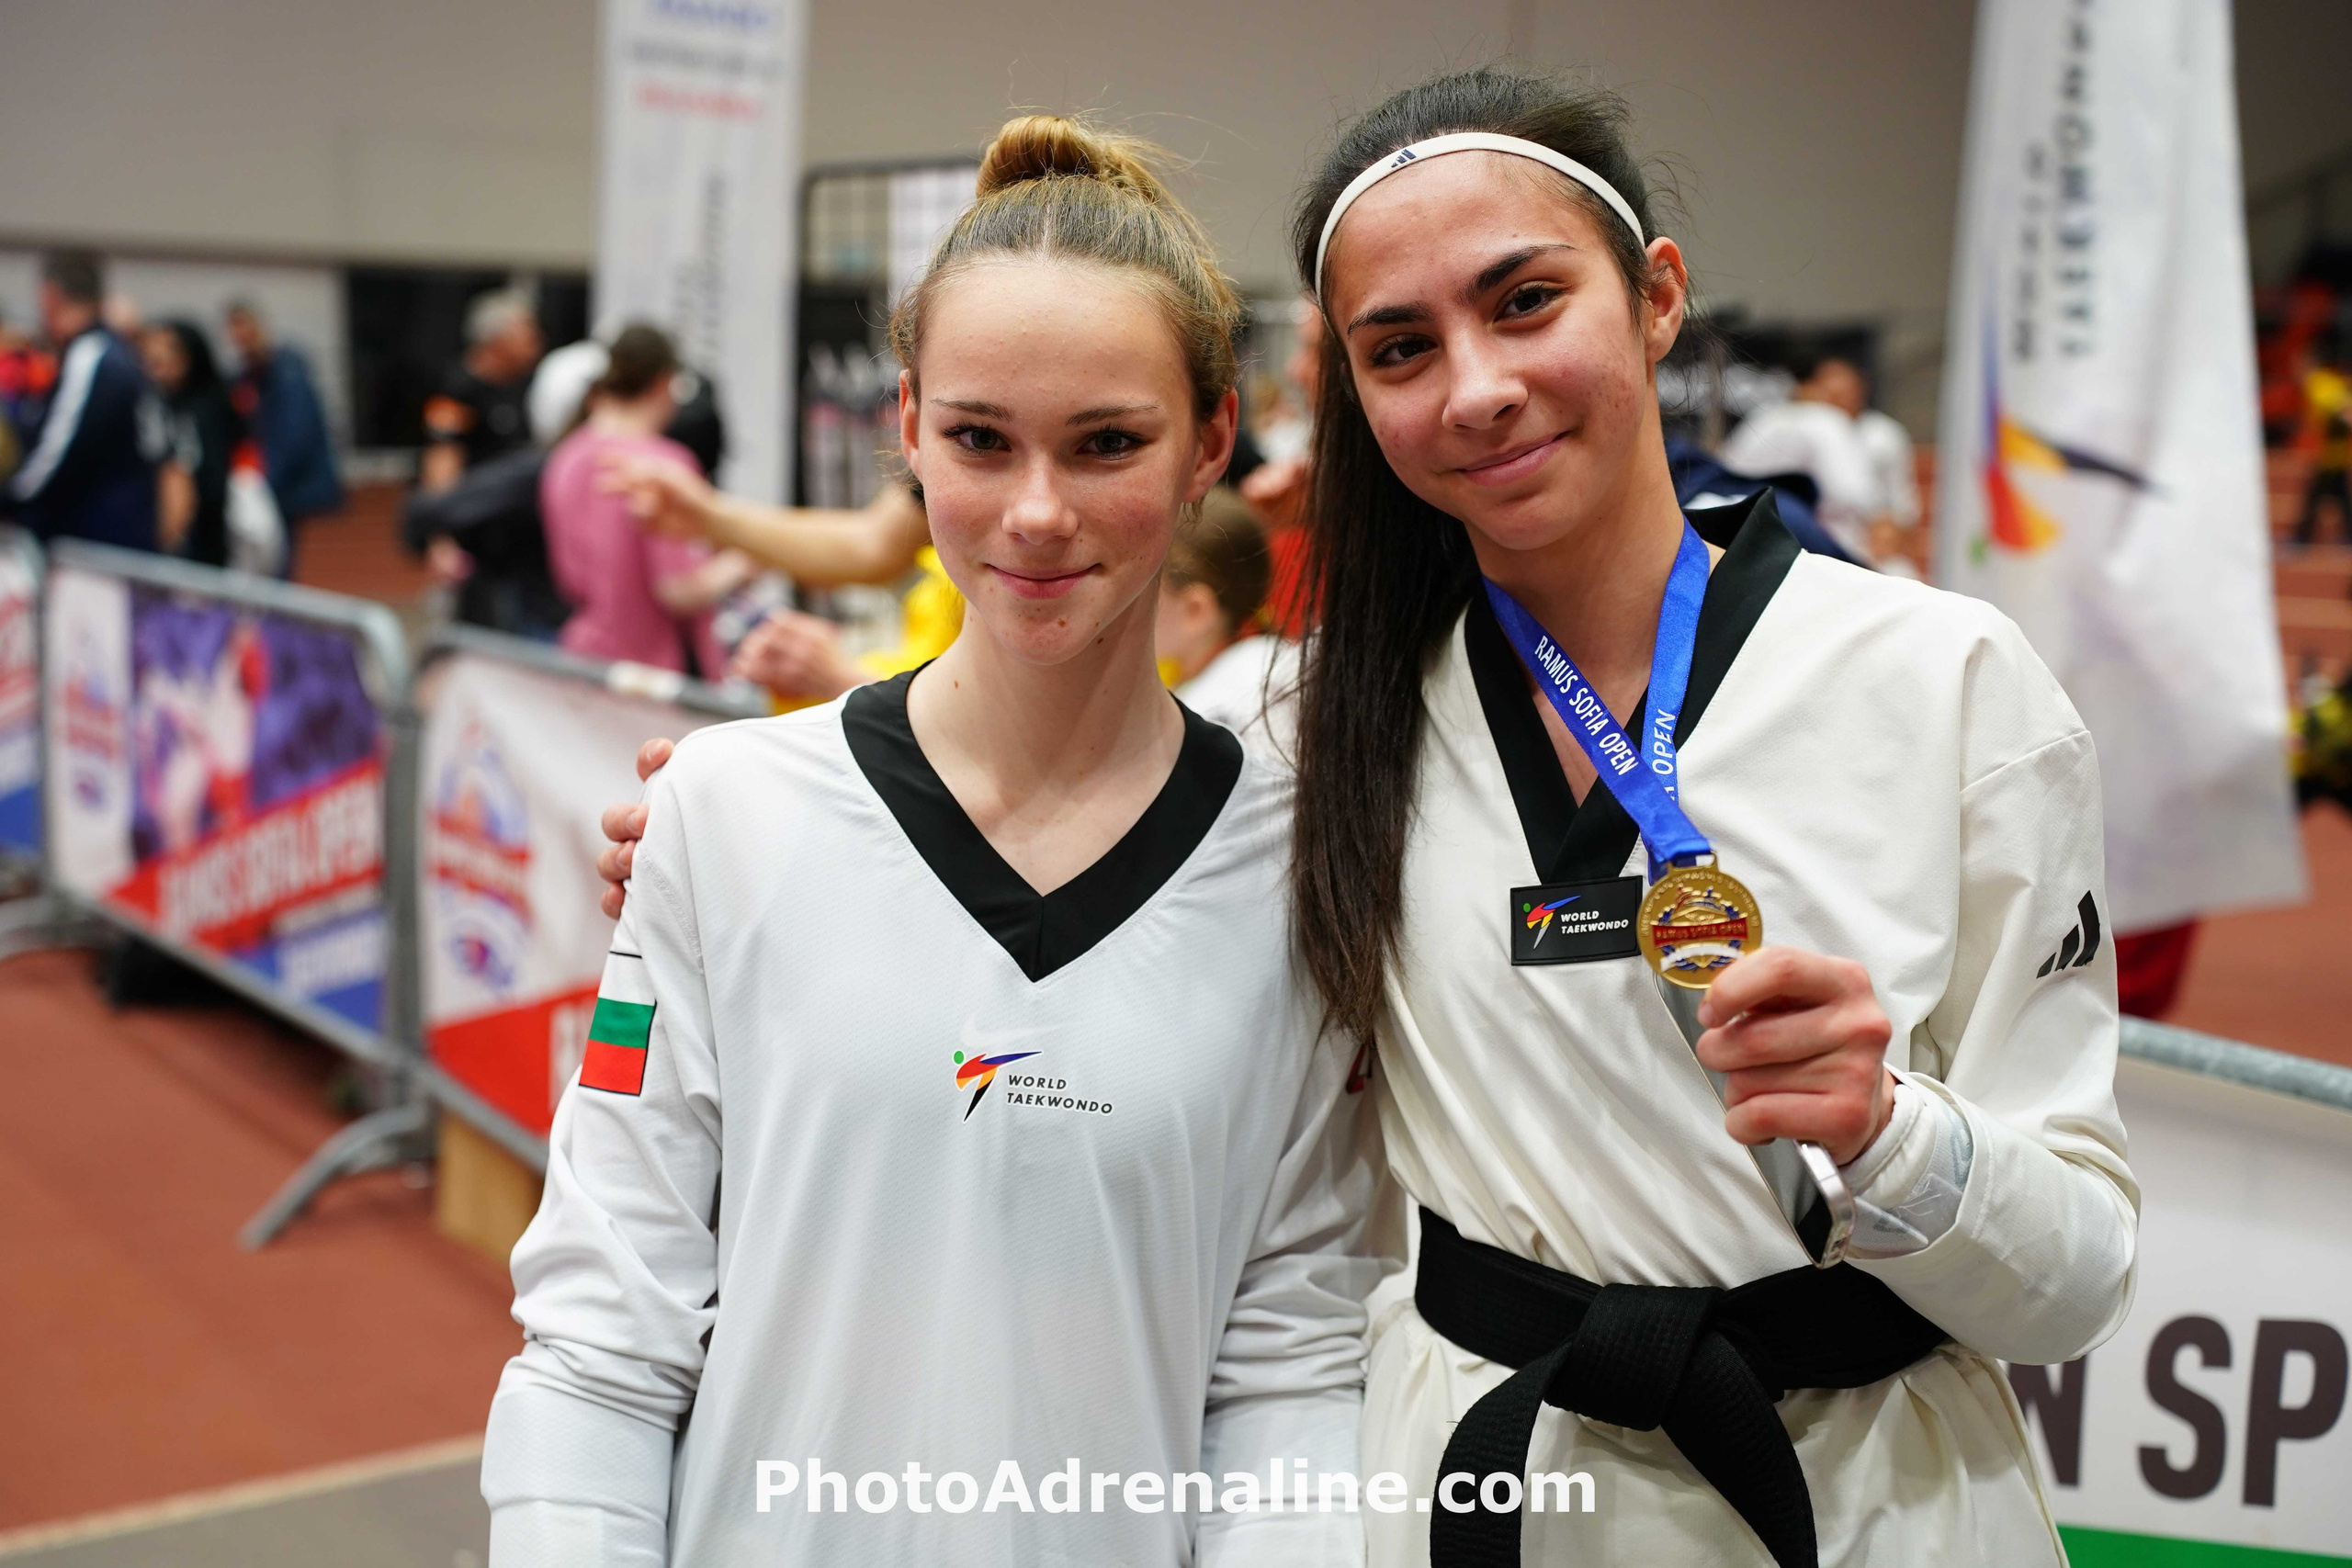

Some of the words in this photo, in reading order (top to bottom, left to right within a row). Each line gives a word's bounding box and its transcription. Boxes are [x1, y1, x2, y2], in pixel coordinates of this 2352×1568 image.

[1534, 635, 1578, 694] RAMUS
[1569, 687, 1609, 736] SOFIA
[1599, 732, 1639, 776] OPEN
[1652, 709, 1676, 774] OPEN
[1560, 910, 1600, 922] WORLD
[1561, 919, 1629, 934] TAEKWONDO
[1008, 1075, 1067, 1089] WORLD
[1007, 1092, 1114, 1114] TAEKWONDO
[2138, 1314, 2349, 1507] SP
